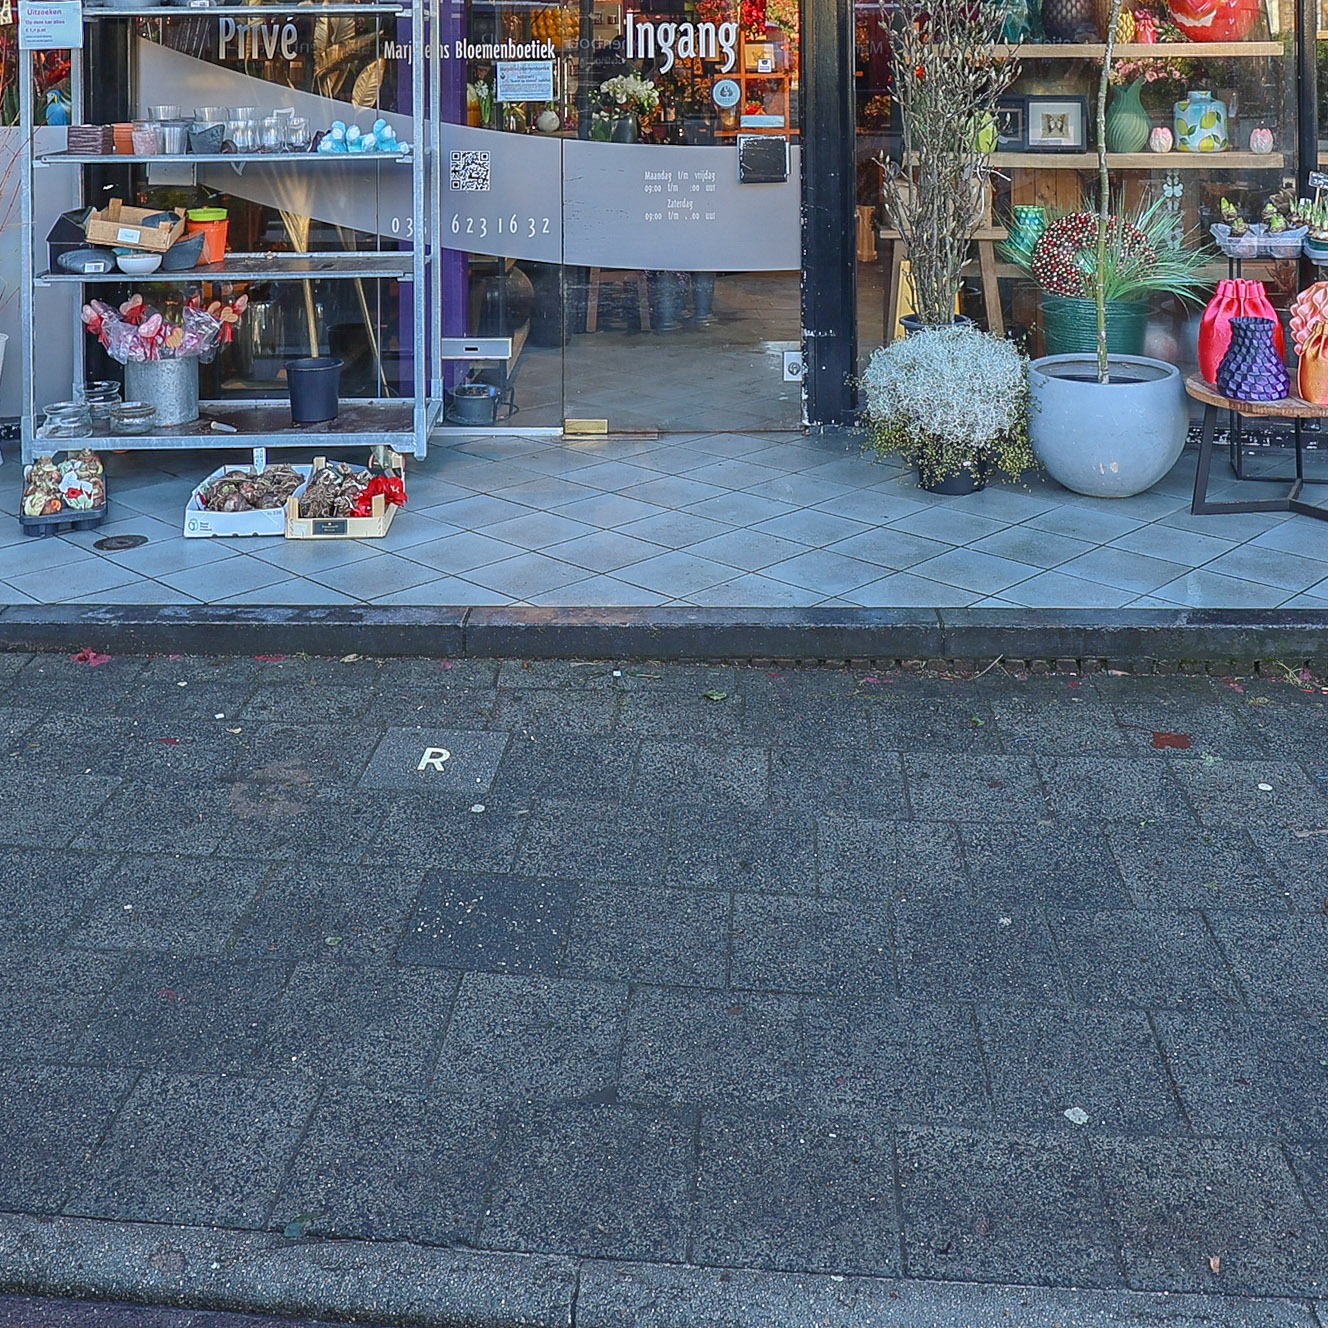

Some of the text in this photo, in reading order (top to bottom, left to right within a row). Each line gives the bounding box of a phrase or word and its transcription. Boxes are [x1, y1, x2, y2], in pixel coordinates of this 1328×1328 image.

[26, 8, 63, 16] Uitzoeken
[218, 16, 298, 61] Privé
[625, 12, 739, 74] Ingang
[455, 37, 556, 60] Bloemenboetiek
[644, 169, 716, 183] Maandag t/m vrijdag
[644, 183, 663, 194] 09:00
[667, 182, 680, 192] t/m
[705, 183, 717, 193] uur
[666, 197, 694, 211] Zaterdag
[644, 212, 663, 222] 09:00
[668, 211, 680, 221] t/m
[705, 212, 717, 221] uur
[416, 746, 451, 772] R
